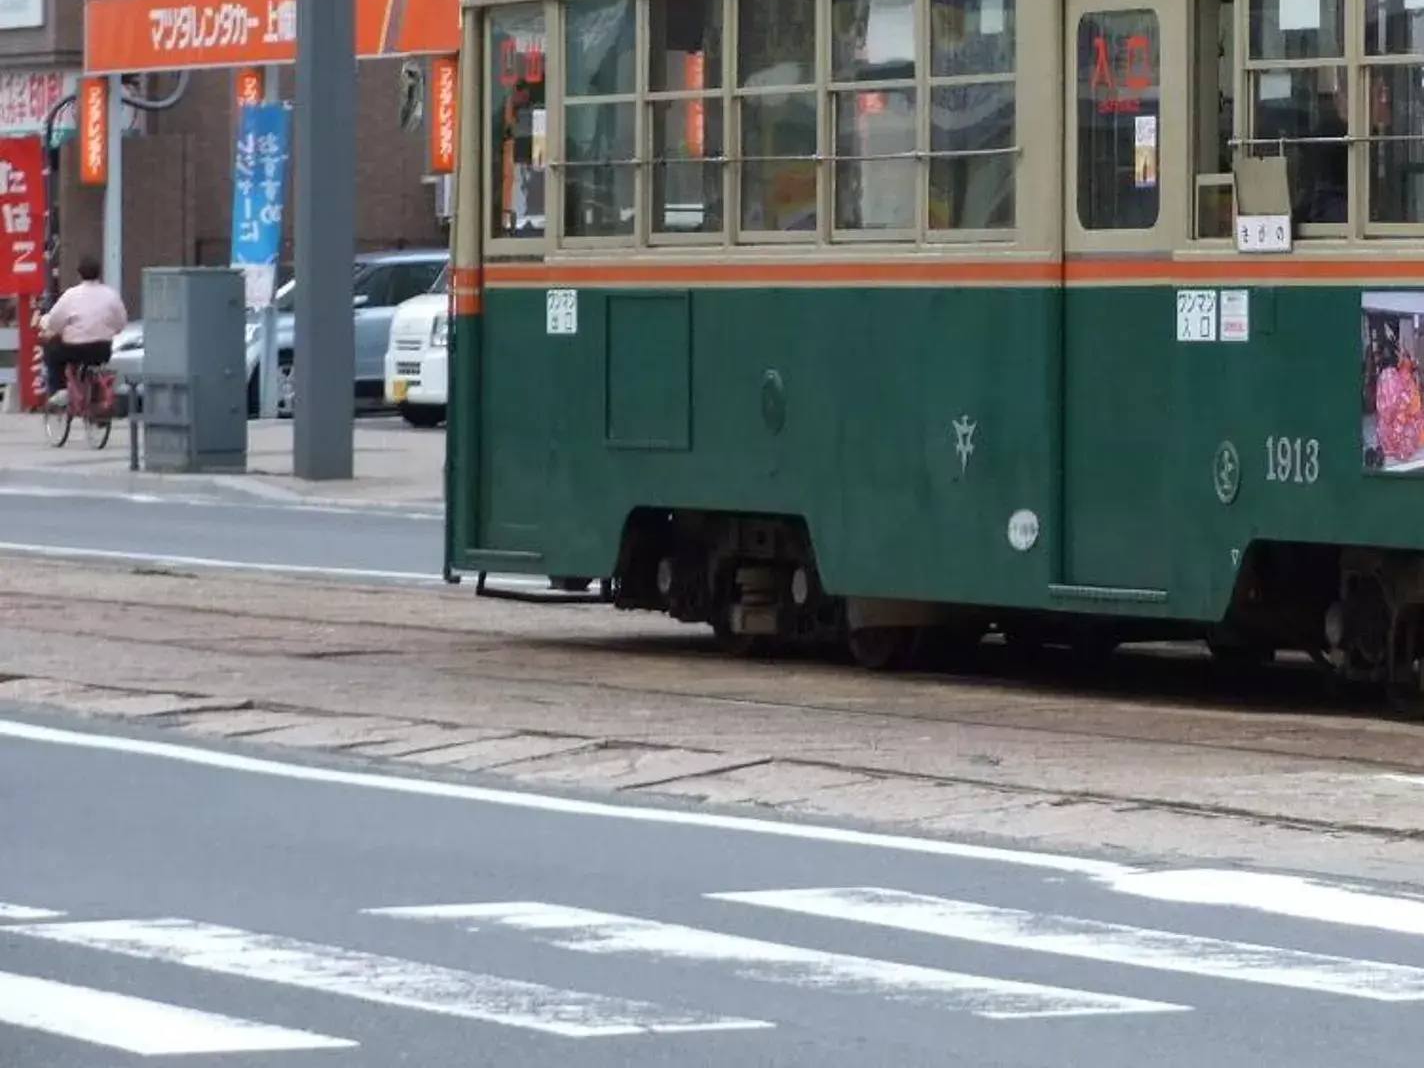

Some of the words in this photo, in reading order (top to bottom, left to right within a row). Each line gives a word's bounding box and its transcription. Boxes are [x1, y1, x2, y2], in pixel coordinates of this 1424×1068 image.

[149, 4, 259, 50] マツダレンタカー
[1178, 292, 1216, 313] ワンマン
[1183, 315, 1211, 338] 入口
[1265, 435, 1320, 483] 1913
